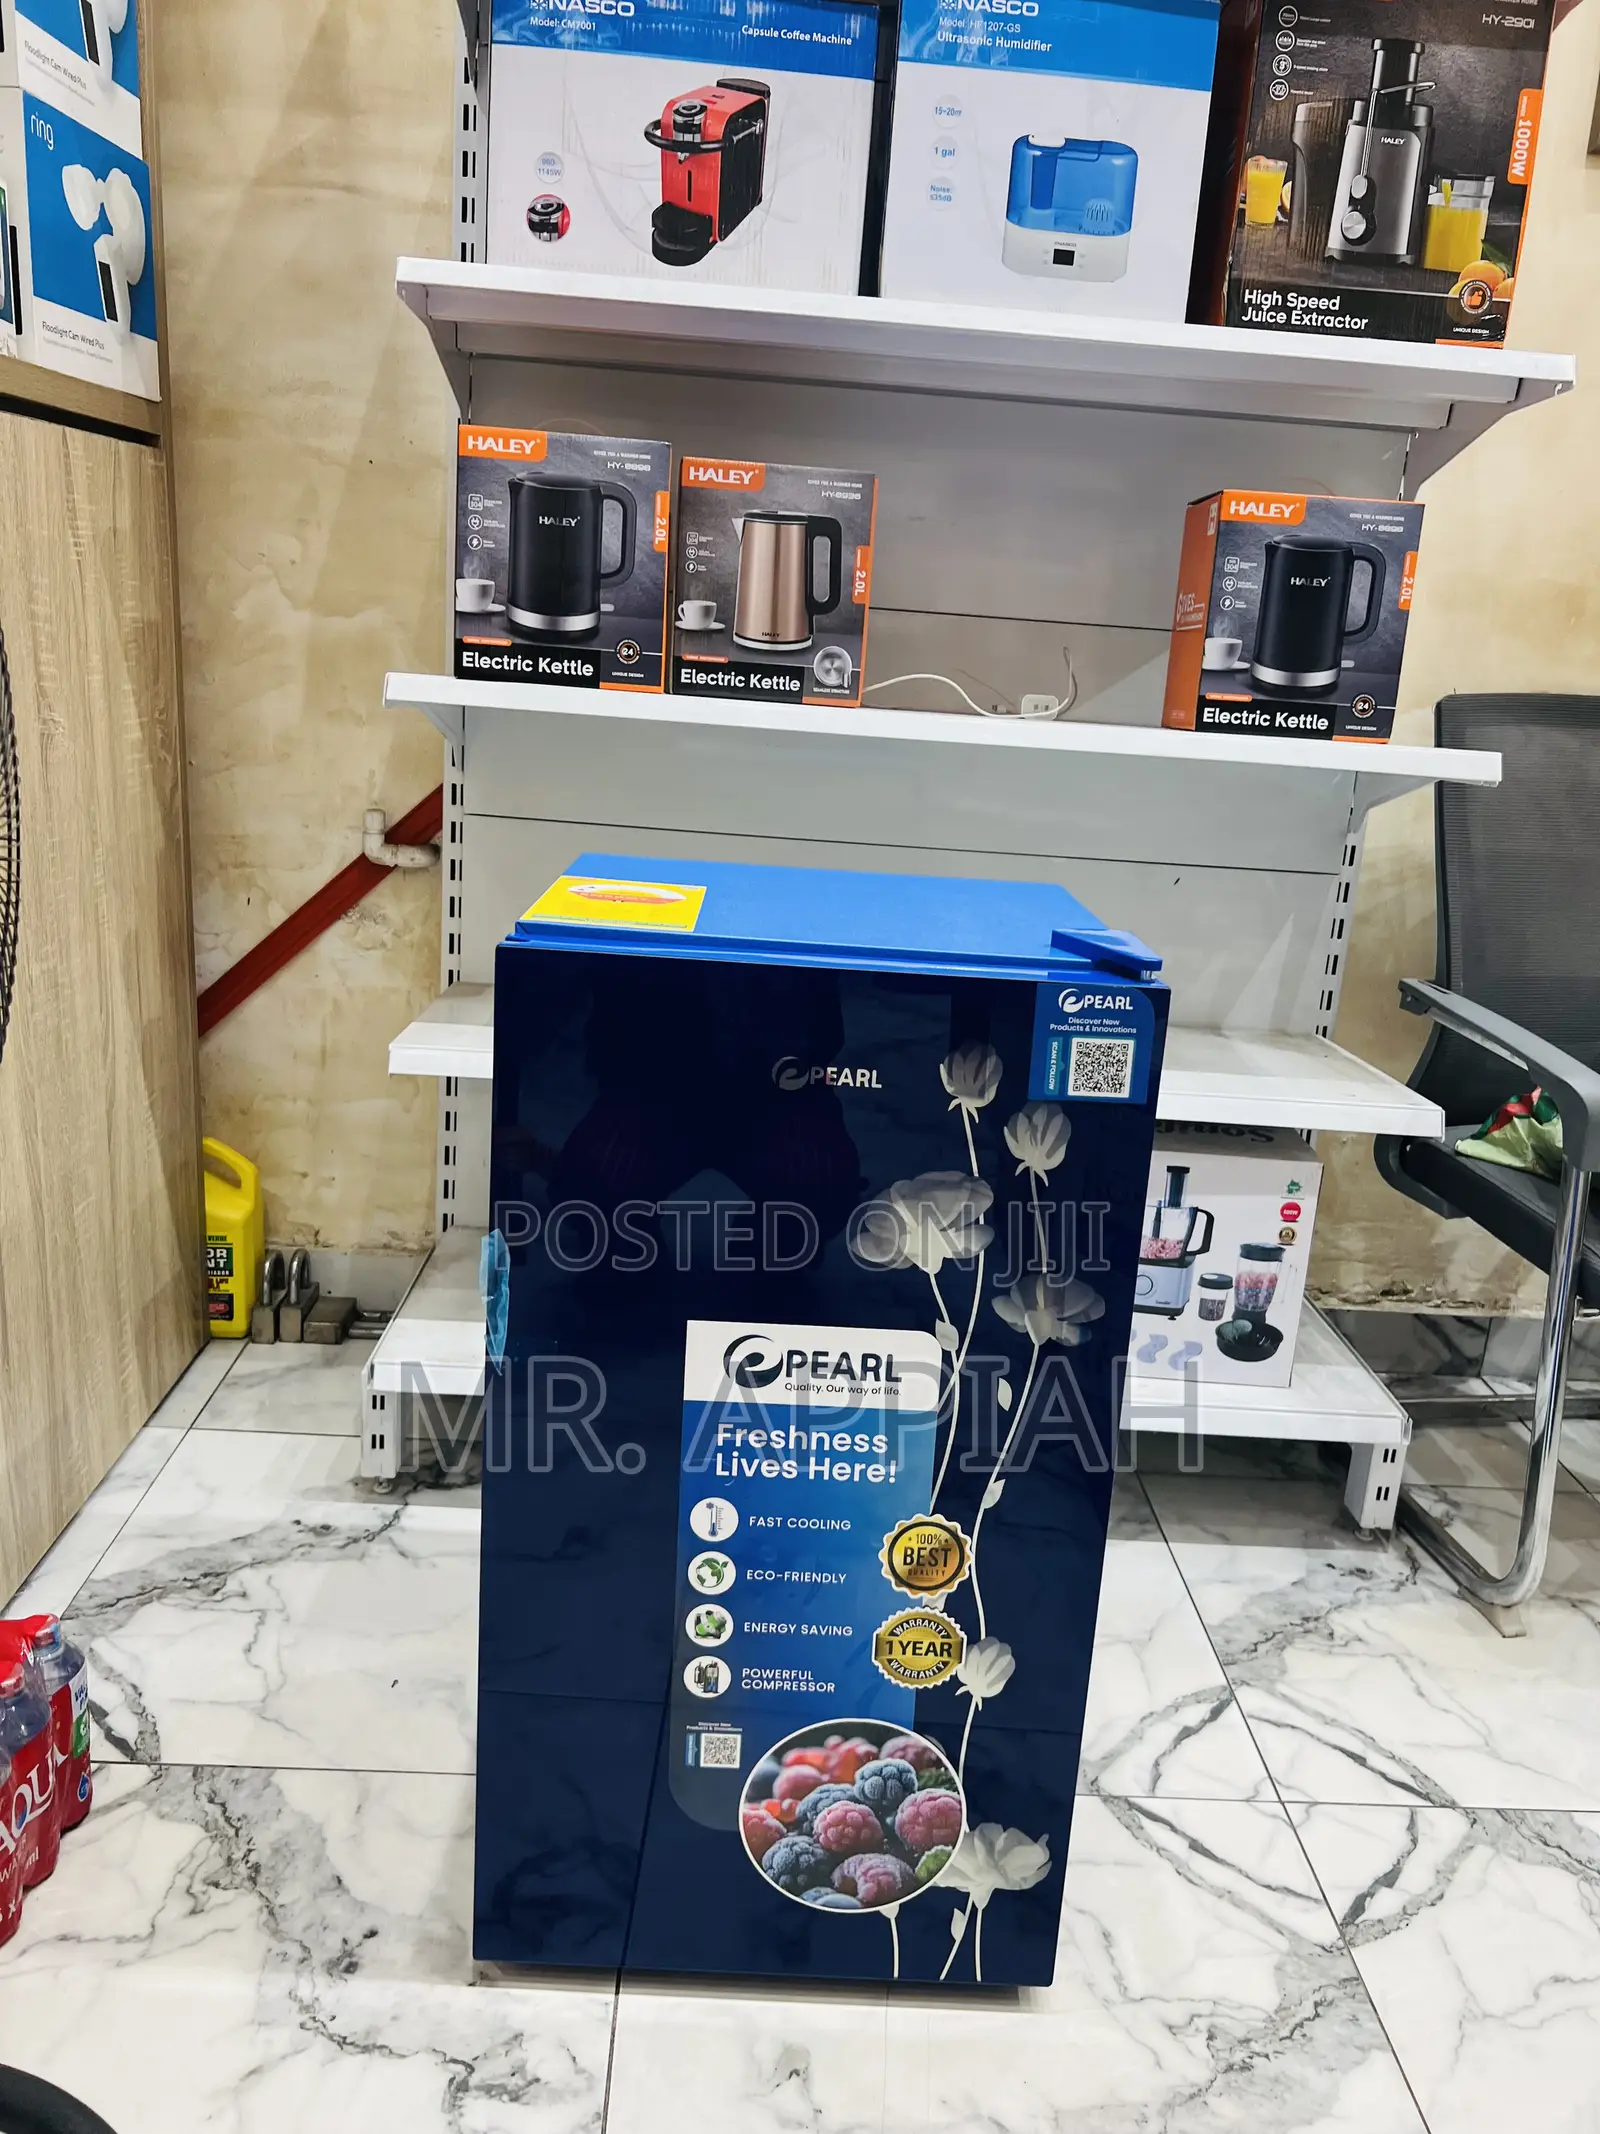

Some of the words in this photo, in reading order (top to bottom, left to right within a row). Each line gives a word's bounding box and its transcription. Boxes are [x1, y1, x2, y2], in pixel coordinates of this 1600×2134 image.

[549, 0, 635, 17] NASCO
[958, 0, 1040, 17] NASCO
[530, 16, 559, 28] Model:
[561, 19, 597, 31] CM7001
[741, 25, 779, 38] Capsule
[780, 29, 811, 41] Coffee
[812, 32, 853, 45] Machine
[937, 31, 993, 47] Ultrasonic
[996, 36, 1053, 52] Humidifier
[30, 111, 54, 150] ring
[1381, 136, 1405, 145] HALEY
[1512, 119, 1532, 177] 1000W
[941, 148, 956, 158] gal
[1243, 288, 1282, 309] High
[1286, 292, 1341, 311] Speed
[1241, 305, 1287, 324] Juice
[1290, 310, 1369, 330] Extractor
[42, 320, 68, 339] Floodlight
[68, 329, 80, 342] Cam
[80, 334, 95, 347] Wired
[94, 338, 105, 350] Plus
[467, 435, 536, 455] HALEY
[689, 466, 754, 485] HALEY
[1229, 500, 1296, 518] HALEY
[539, 515, 578, 527] HALEY
[655, 517, 667, 545] 2.0L
[854, 570, 867, 597] 2.0L
[1290, 577, 1328, 587] HALEY
[1400, 576, 1414, 604] 2.0L
[622, 647, 634, 656] 24
[462, 651, 533, 672] Electric
[538, 657, 594, 677] Kettle
[680, 668, 746, 688] Electric
[750, 674, 801, 692] Kettle
[1356, 702, 1369, 711] 24
[1202, 707, 1271, 728] Electric
[1275, 712, 1329, 731] Kettle
[1083, 994, 1134, 1011] PEARL
[1049, 1023, 1084, 1032] Products
[1084, 1024, 1090, 1032] &
[1091, 1025, 1137, 1034] Innovations
[1068, 1016, 1101, 1025] Discover
[1102, 1018, 1120, 1026] New
[809, 1066, 882, 1088] PEARL
[785, 1349, 902, 1383] PEARL
[785, 1382, 824, 1395] Quality.
[826, 1384, 844, 1393] Our
[847, 1386, 869, 1396] way
[871, 1386, 882, 1395] of
[884, 1386, 902, 1396] life.
[717, 1423, 888, 1454] Freshness
[715, 1450, 798, 1479] Lives
[808, 1456, 897, 1484] Here!
[749, 1515, 783, 1528] FAST
[787, 1517, 852, 1531] COOLING
[915, 1533, 943, 1546] 100%
[902, 1545, 953, 1568] BEST
[746, 1569, 847, 1584] ECO-FRIENDLY
[907, 1568, 947, 1578] QUALITY
[744, 1621, 797, 1634] ENERGY
[801, 1624, 853, 1637] SAVING
[893, 1618, 948, 1637] WARRANTY
[885, 1640, 895, 1656] 1
[895, 1640, 953, 1658] YEAR
[742, 1667, 814, 1681] POWERFUL
[890, 1660, 945, 1680] WARRANTY
[741, 1679, 836, 1694] COMPRESSOR
